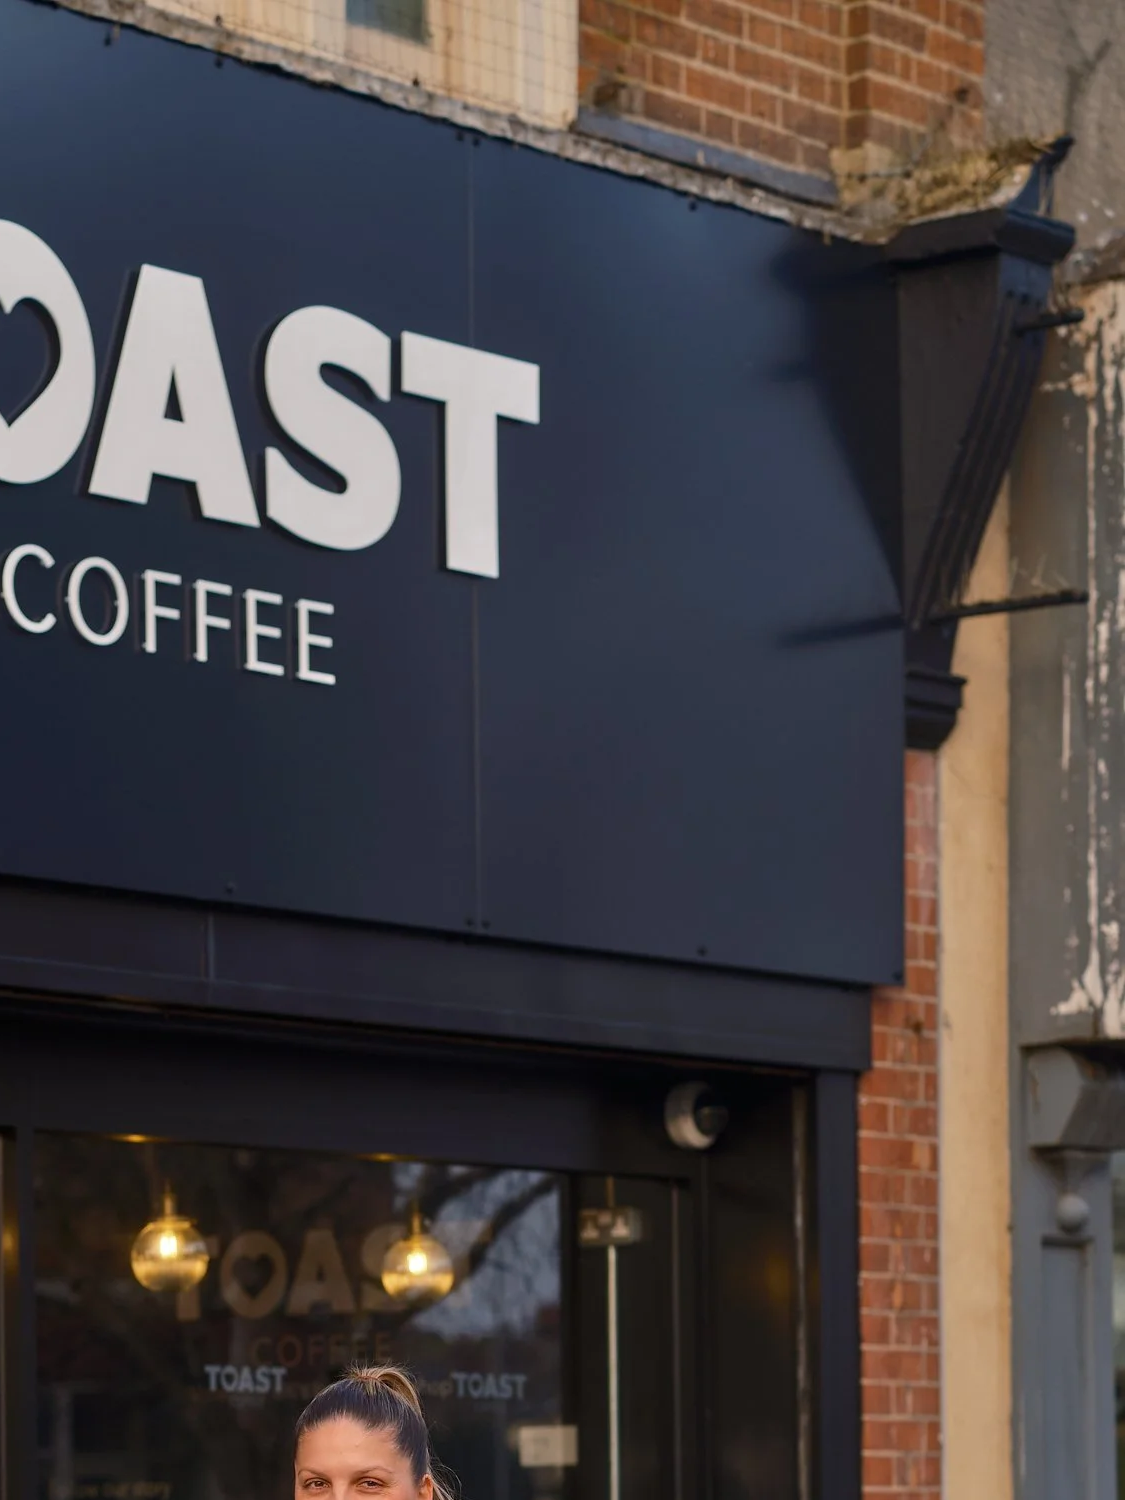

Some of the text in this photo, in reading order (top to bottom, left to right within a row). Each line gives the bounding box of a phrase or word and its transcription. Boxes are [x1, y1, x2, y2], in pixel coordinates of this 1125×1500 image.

[1, 543, 336, 685] COFFEE
[204, 1364, 287, 1395] TOAST
[450, 1370, 528, 1400] TOAST
